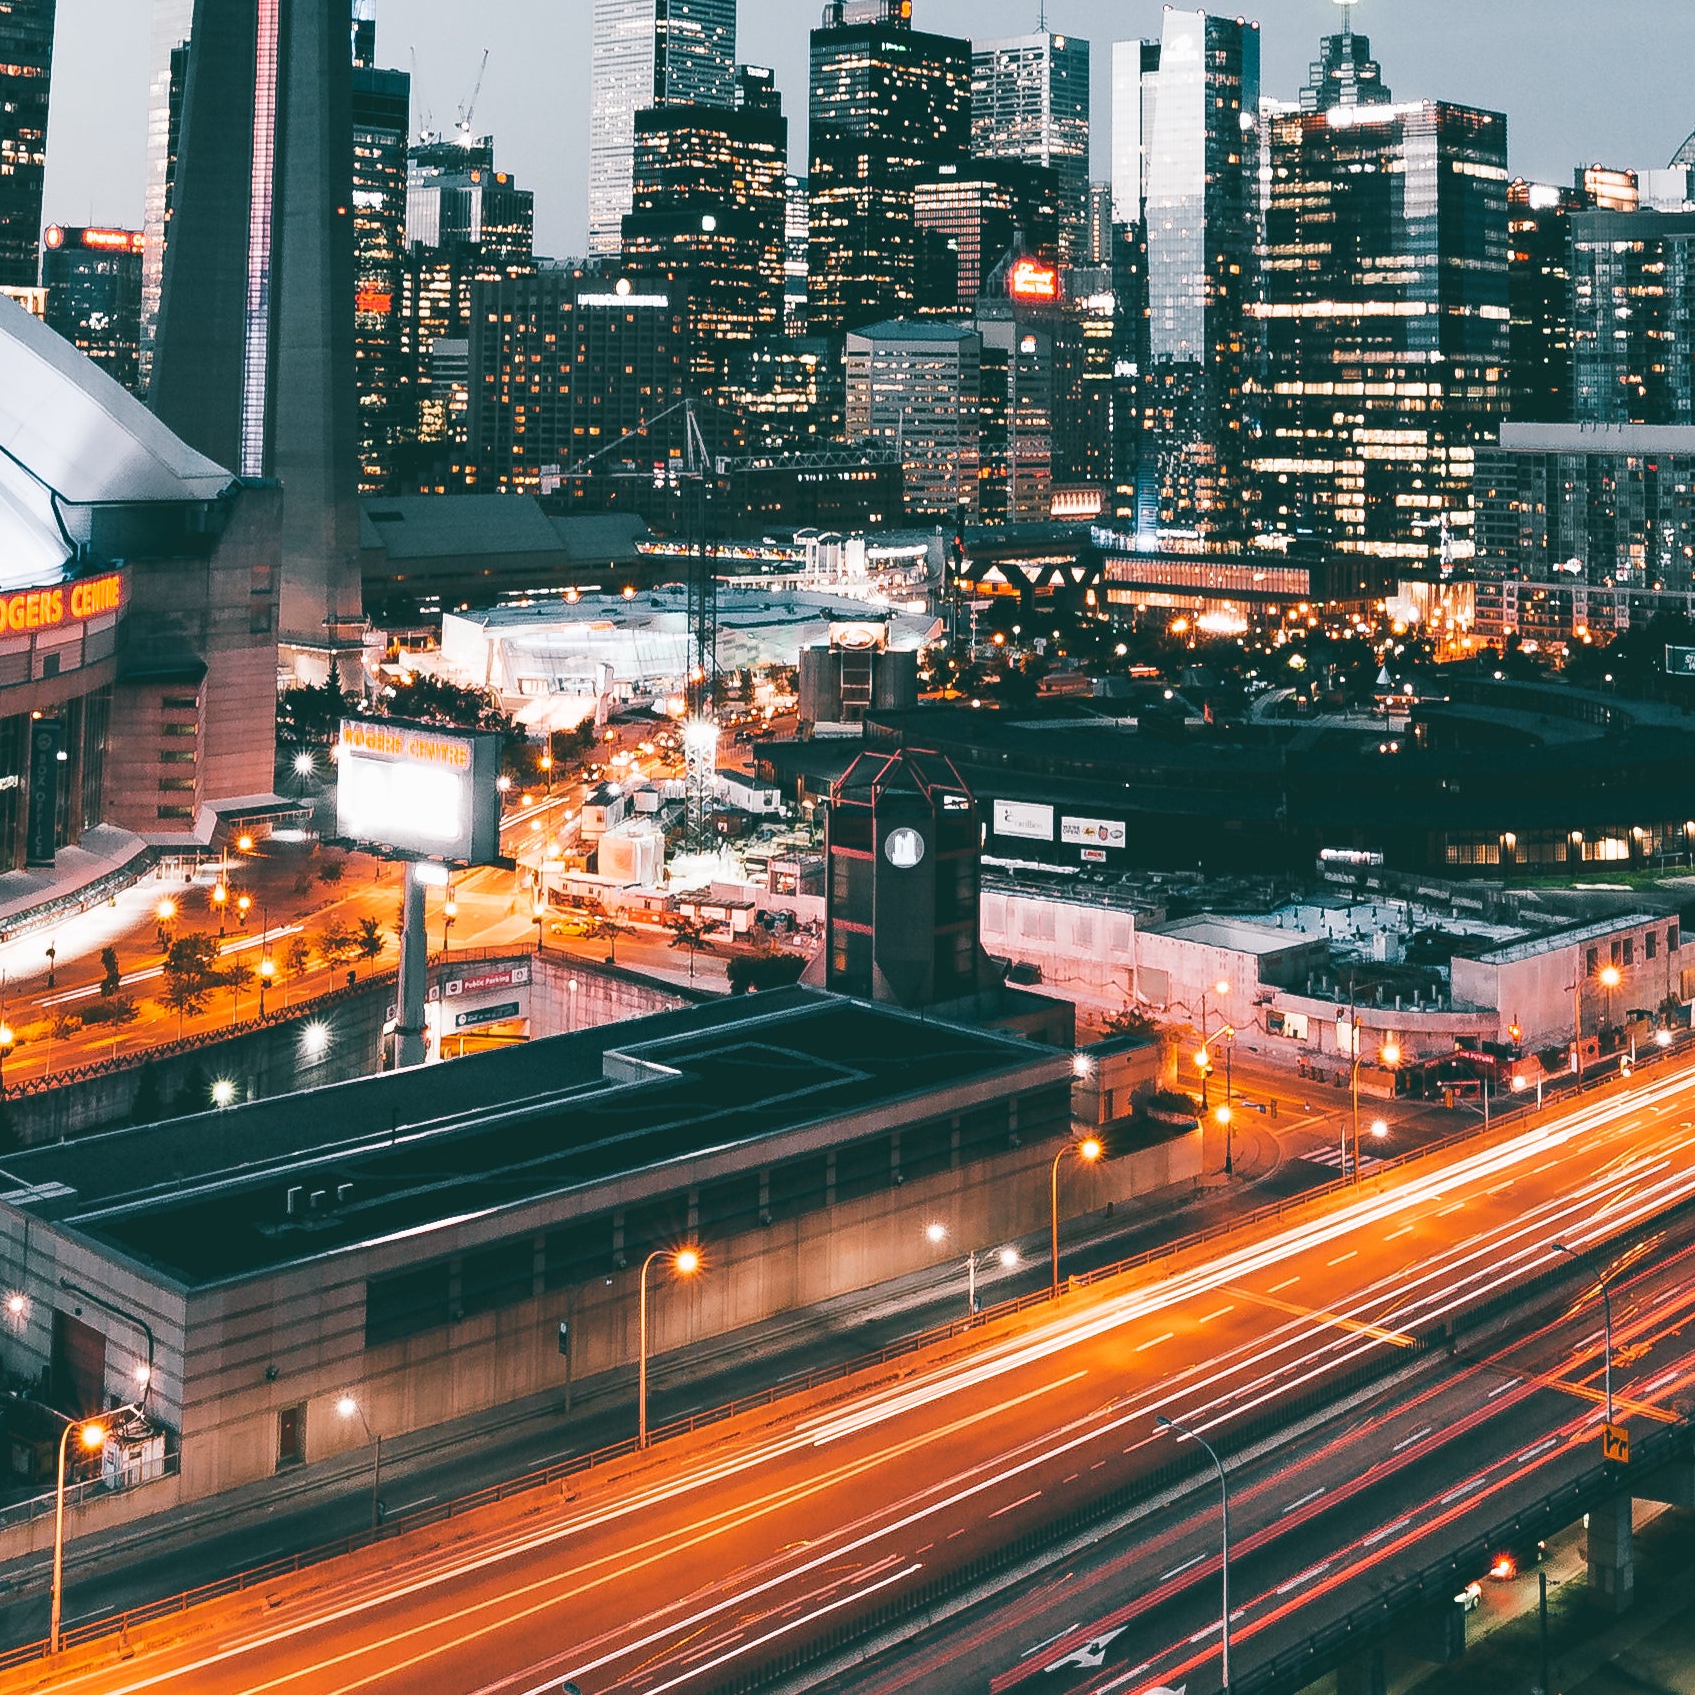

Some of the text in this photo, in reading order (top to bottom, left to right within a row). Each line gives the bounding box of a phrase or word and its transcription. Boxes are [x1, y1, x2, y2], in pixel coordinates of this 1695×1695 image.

[70, 574, 121, 618] CENTRE
[343, 724, 469, 768] ROGERS CENTRE
[35, 753, 48, 856] BOX OFFICE
[464, 974, 510, 989] Public Parking
